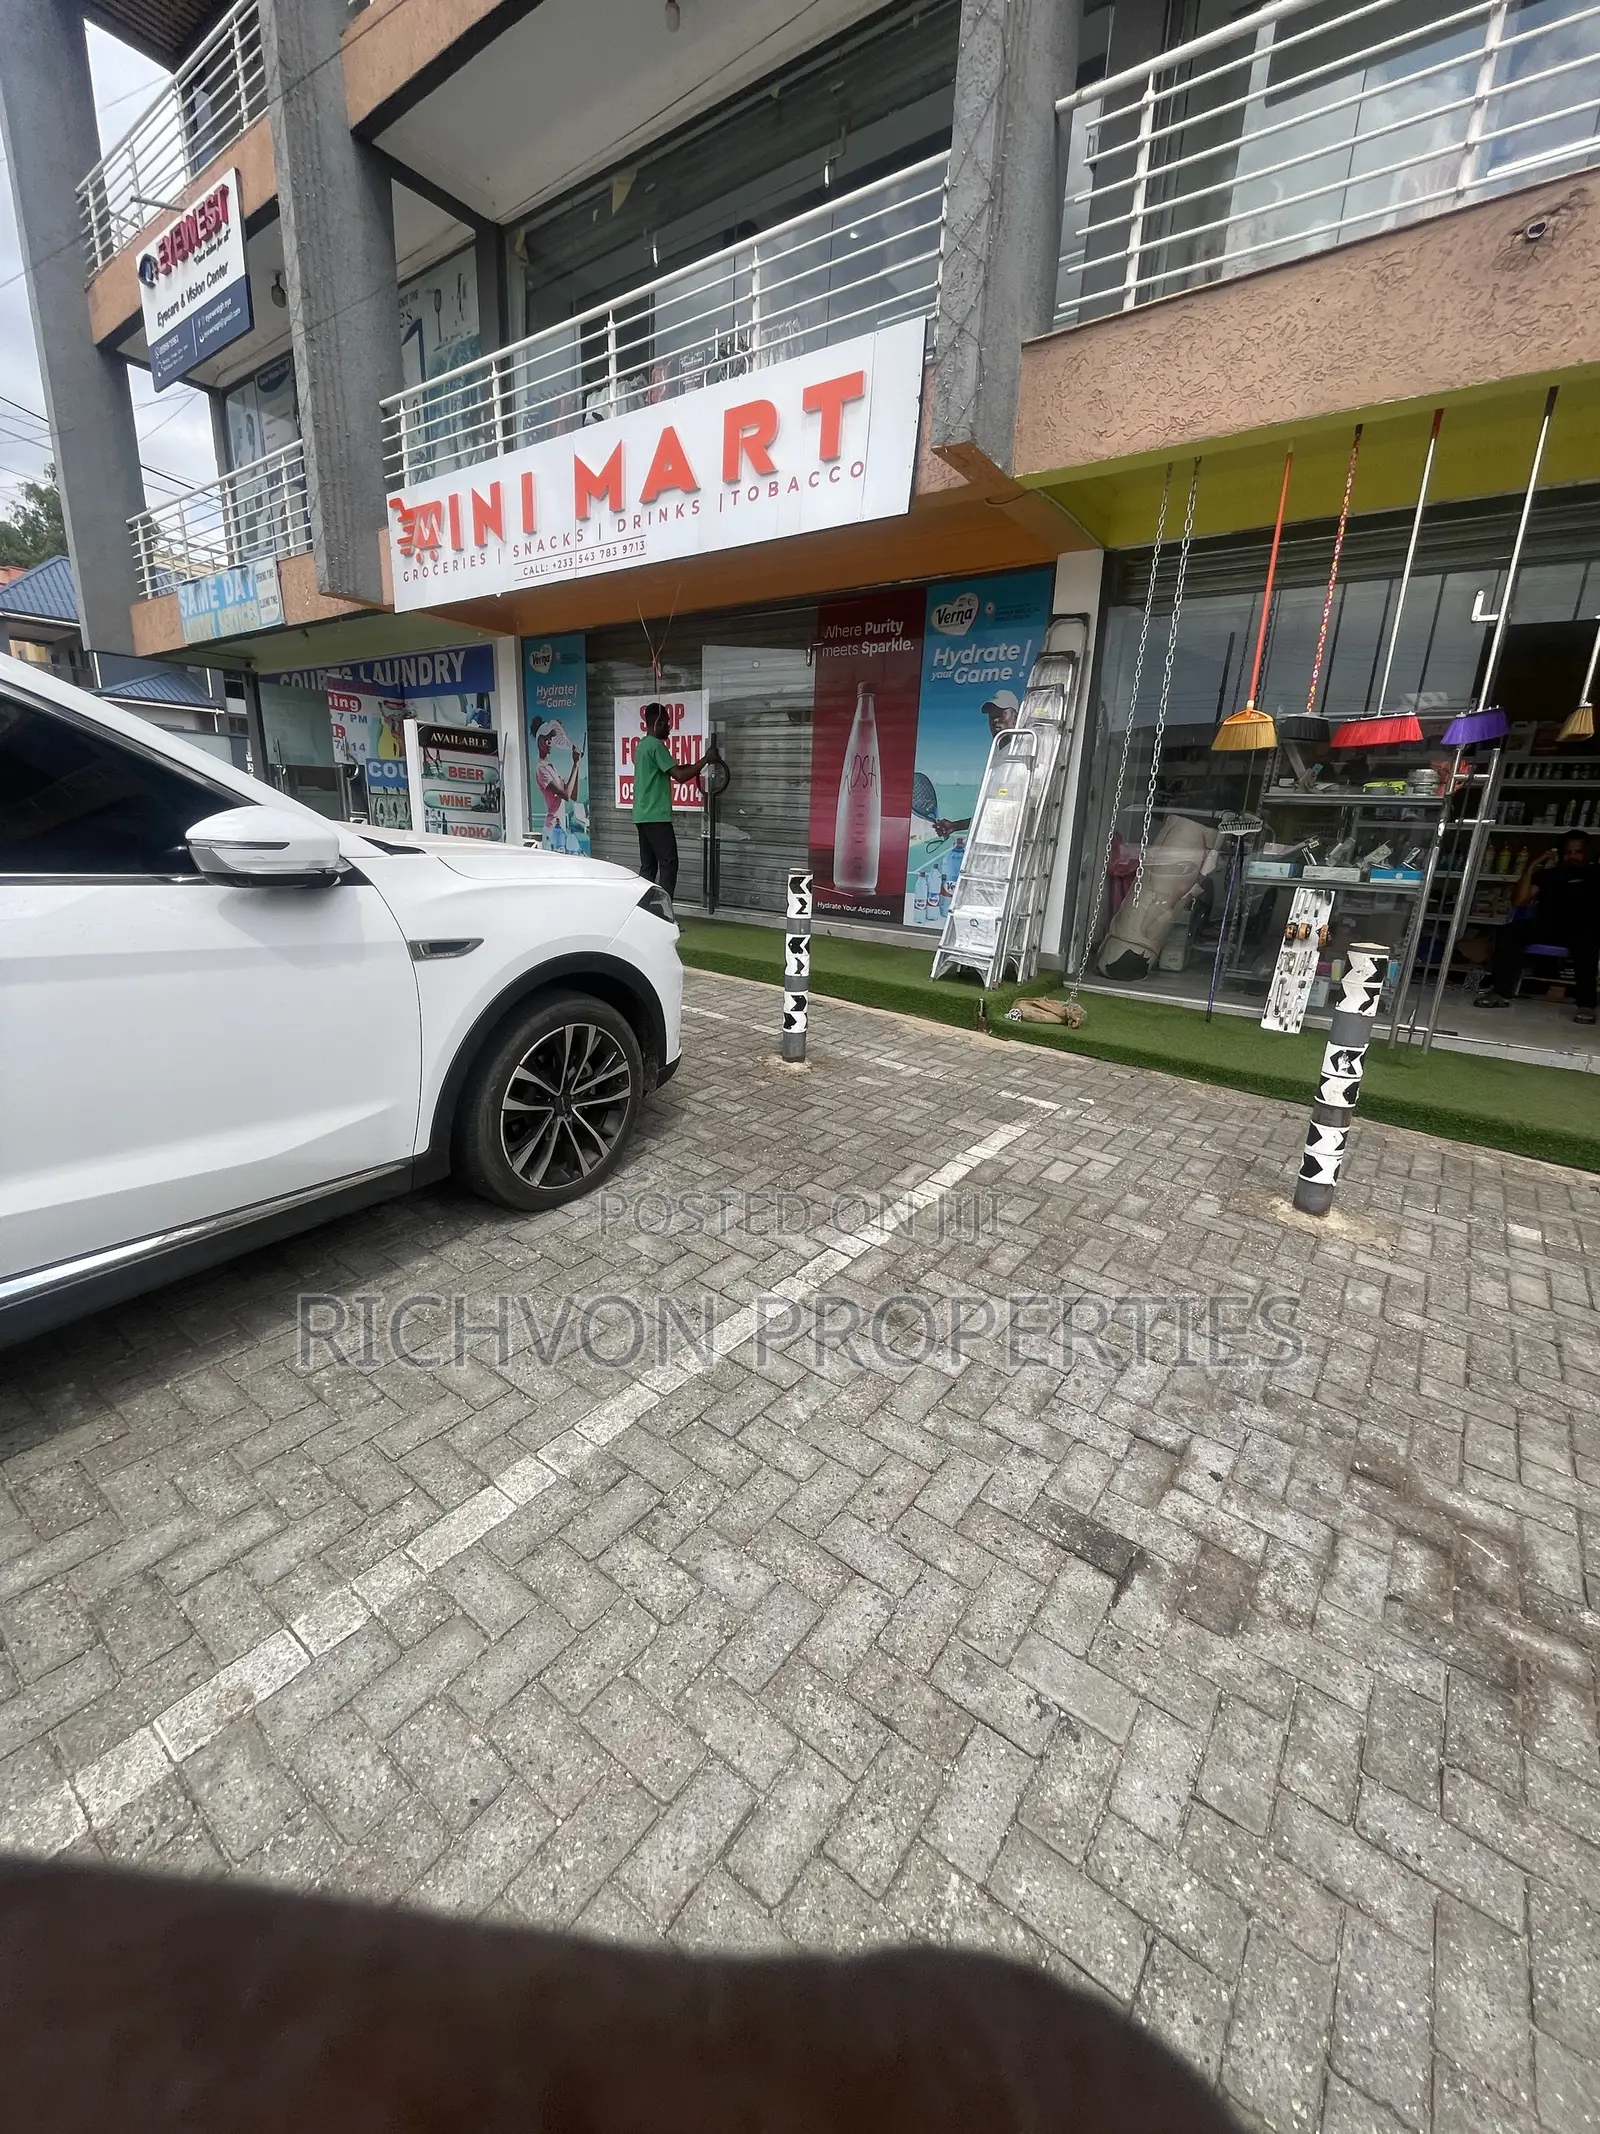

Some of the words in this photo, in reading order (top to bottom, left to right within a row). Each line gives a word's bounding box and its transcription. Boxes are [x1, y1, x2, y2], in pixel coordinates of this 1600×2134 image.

[157, 301, 180, 328] Eyecare
[185, 280, 206, 303] Vision
[206, 261, 228, 288] Center
[574, 370, 866, 521] MART
[403, 554, 486, 582] GROCERIES
[513, 529, 584, 558] SNACKS
[617, 500, 700, 533] DRINKS
[523, 563, 549, 576] CALL:
[552, 558, 573, 569] +233
[578, 552, 596, 564] 543
[600, 548, 618, 561] 783
[622, 541, 646, 554] 9713
[179, 577, 220, 619] SAME
[222, 563, 255, 607] DAY
[936, 607, 973, 625] Verna
[823, 623, 862, 640] Where
[864, 619, 904, 637] Purity
[822, 644, 859, 658] meets
[861, 639, 915, 657] Sparkle.
[932, 642, 1021, 671] Hydrate
[359, 651, 467, 688] LAUNDRY
[930, 671, 953, 682] your
[953, 666, 1013, 685] Game
[536, 684, 574, 699] Hydrate
[546, 698, 572, 708] Game
[350, 713, 368, 724] PM
[639, 703, 685, 732] SOP
[430, 732, 489, 748] AVAILABLE
[448, 766, 485, 780] BEER
[438, 794, 472, 808] WINE
[450, 825, 493, 838] VODKA
[817, 901, 842, 911] Hydrate
[842, 904, 857, 913] Your
[857, 905, 891, 916] Aspiration
